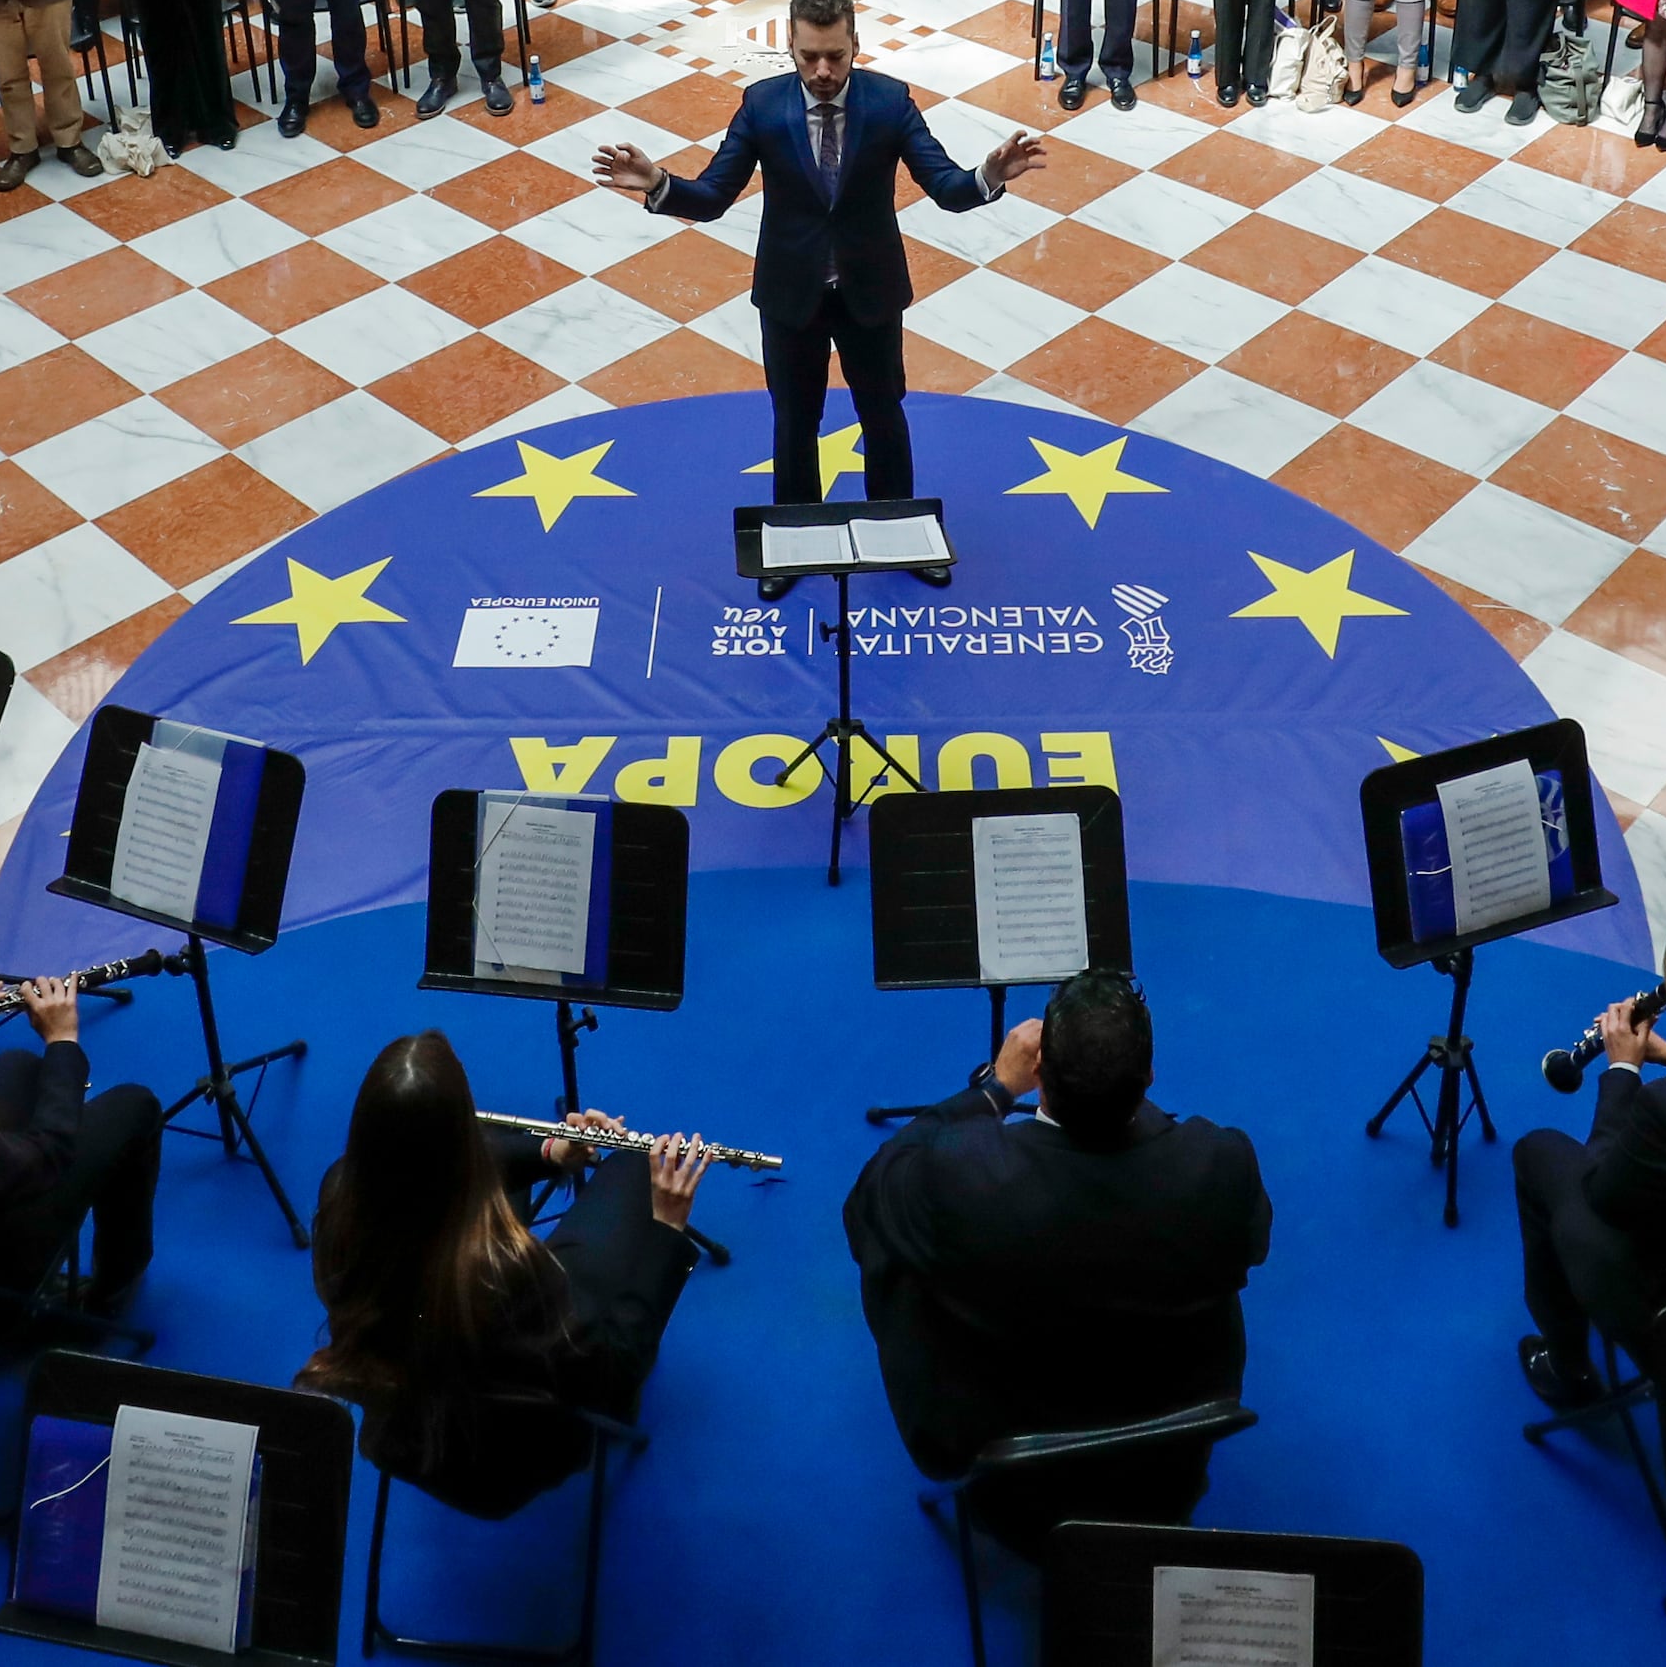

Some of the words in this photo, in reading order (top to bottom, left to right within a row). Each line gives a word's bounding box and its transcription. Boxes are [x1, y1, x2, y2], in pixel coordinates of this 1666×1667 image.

[471, 597, 546, 607] EUROPEA
[549, 597, 600, 608] UNIÓN
[723, 606, 781, 623] veu
[846, 605, 1099, 628] VALENCIANA
[713, 624, 764, 638] UNA
[770, 625, 788, 638] A
[711, 638, 787, 655] TOTS
[508, 730, 1121, 809] EUROPA
